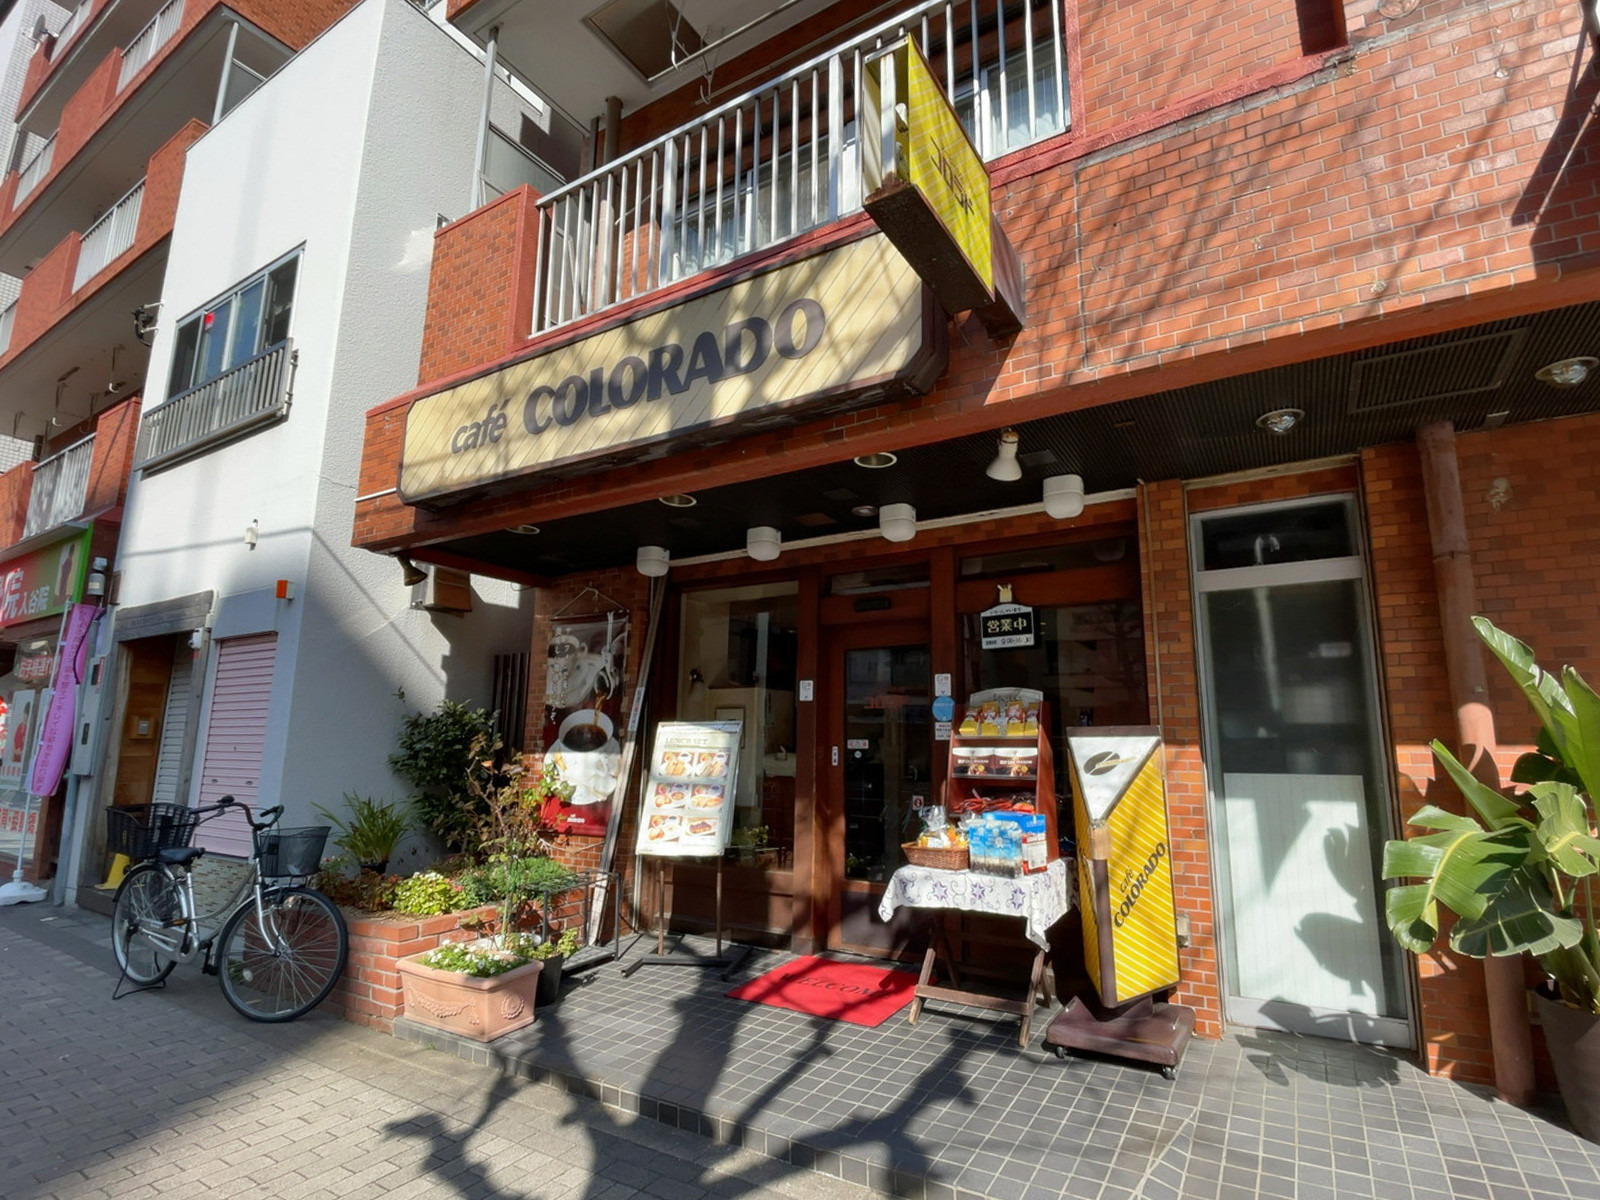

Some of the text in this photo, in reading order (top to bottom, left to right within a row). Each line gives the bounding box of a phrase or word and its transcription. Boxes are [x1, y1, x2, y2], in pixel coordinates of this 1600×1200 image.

[451, 298, 826, 454] café COLORADO
[987, 616, 1028, 633] 営業中
[1114, 842, 1165, 927] COLORADO
[1121, 867, 1134, 893] café
